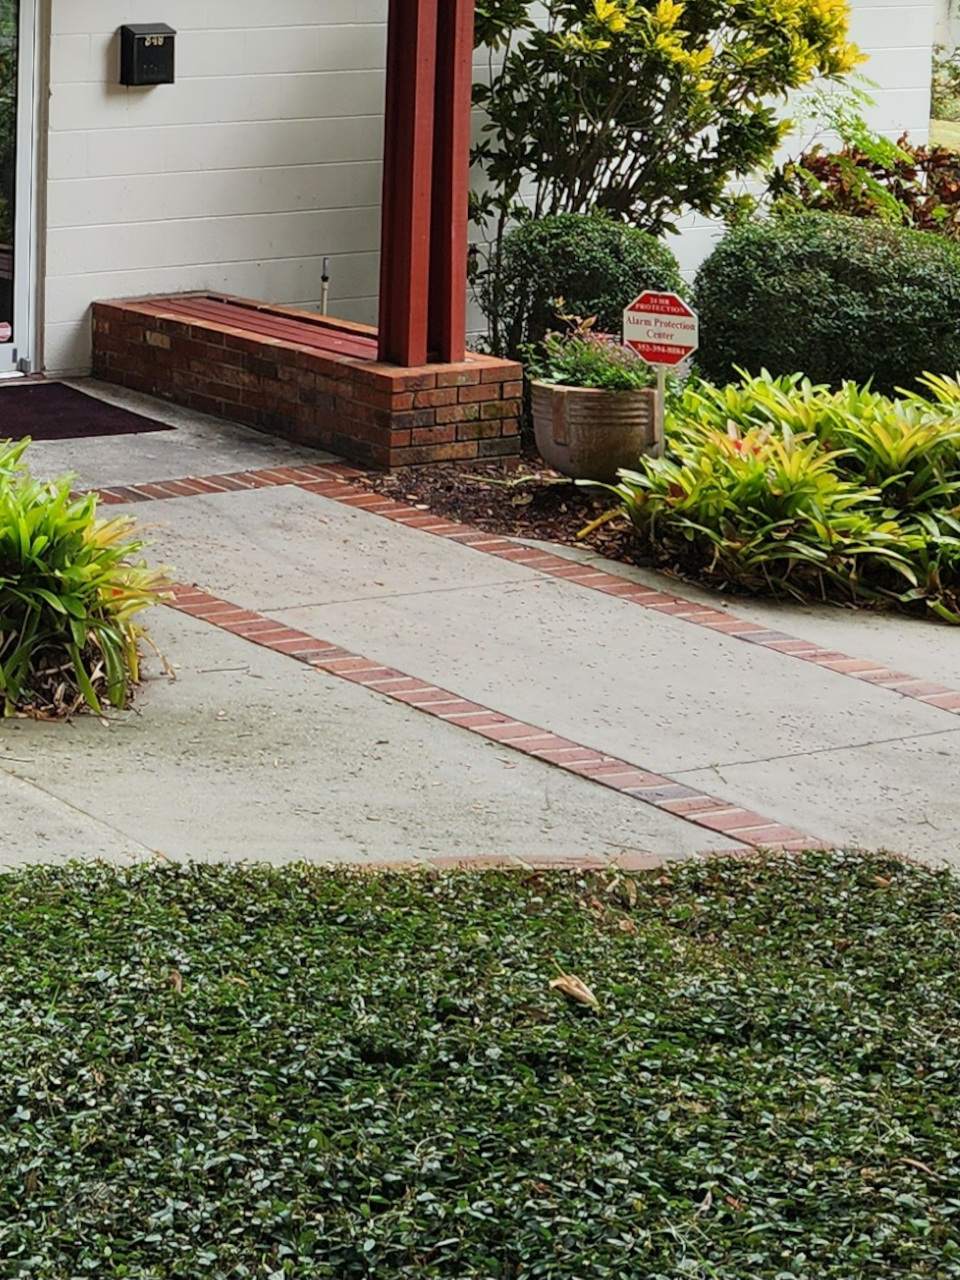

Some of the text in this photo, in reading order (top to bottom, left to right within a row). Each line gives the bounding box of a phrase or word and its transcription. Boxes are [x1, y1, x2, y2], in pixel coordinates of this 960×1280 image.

[635, 303, 685, 313] PROTECTION
[626, 316, 696, 331] Alarm Protection
[646, 329, 674, 340] Center
